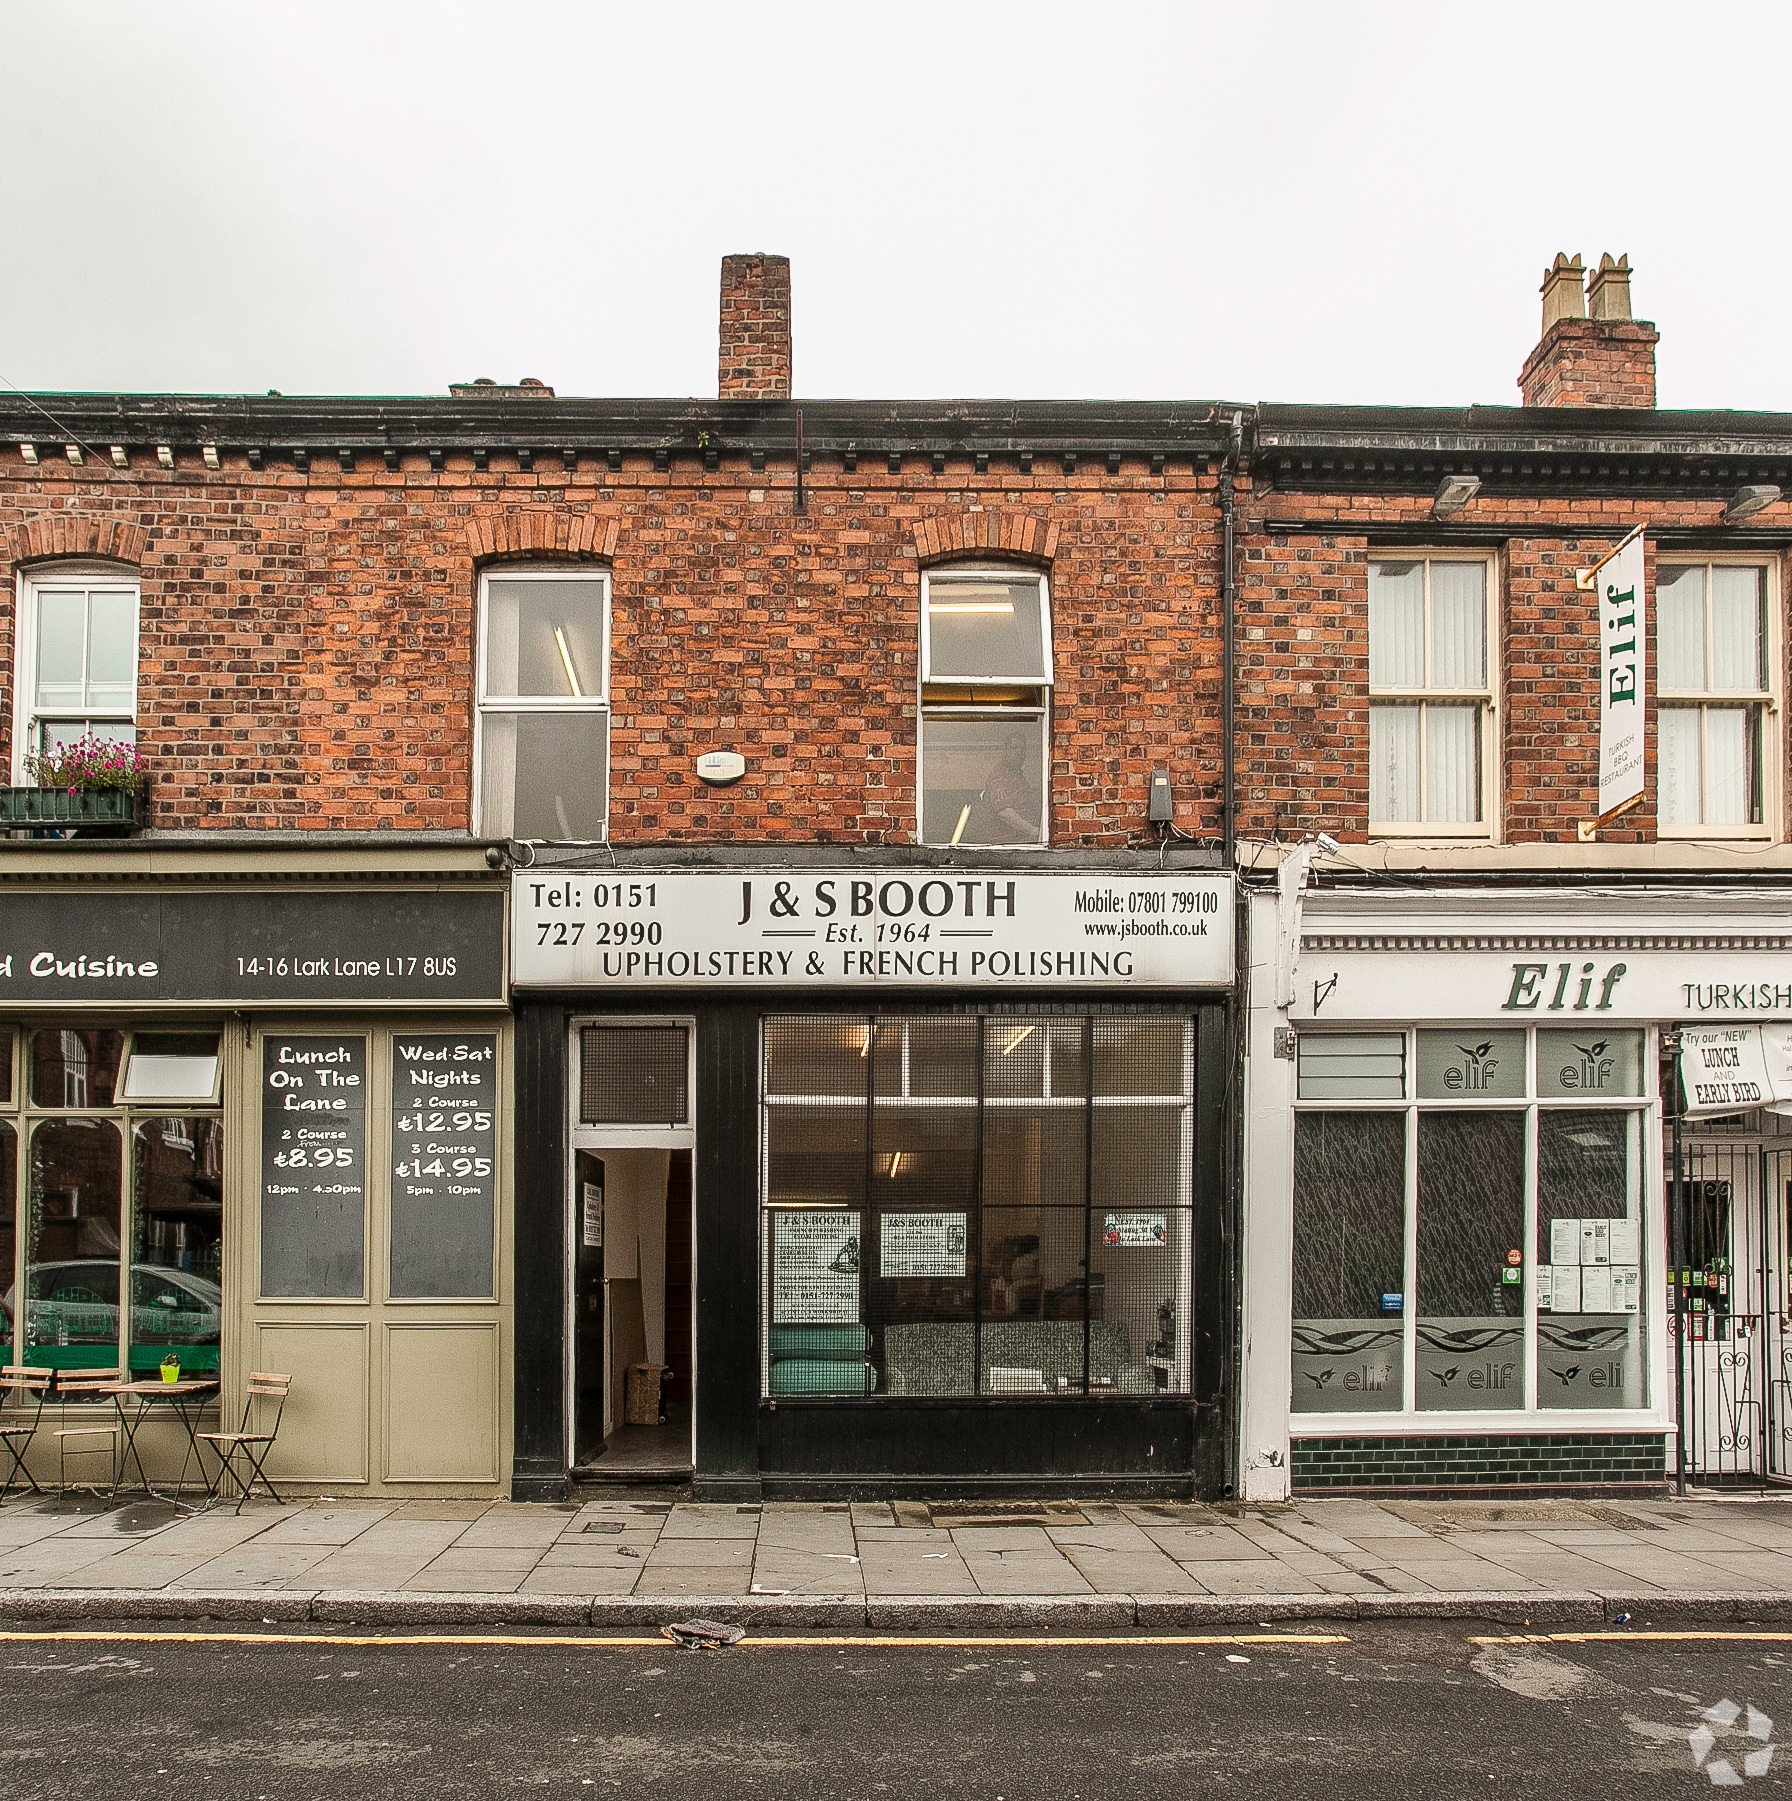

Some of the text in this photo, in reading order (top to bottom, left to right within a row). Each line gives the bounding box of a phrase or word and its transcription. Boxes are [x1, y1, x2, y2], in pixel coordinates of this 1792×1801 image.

[1607, 585, 1635, 709] Elif
[1608, 733, 1635, 757] TURKISH
[1614, 751, 1629, 767] BBQ
[1600, 754, 1643, 788] RESTAURANT
[530, 882, 656, 908] Tel: 0151
[737, 880, 1016, 925] J & S BOOTH
[1074, 889, 1218, 914] Mobile: 07801 799100
[537, 922, 662, 946] 727 2990
[825, 922, 930, 943] Est. 1964
[1084, 918, 1208, 942] www.jsbooth.co.uk
[30, 952, 159, 979] Cuisine
[237, 956, 457, 977] 14-16 Lark Lane L17 8US
[603, 950, 1133, 977] UPHOLSTERY & FRENCH POLISHING
[1501, 962, 1792, 1010] Elif TURKISH
[1686, 1033, 1700, 1046] Try
[1702, 1034, 1718, 1044] our
[279, 1046, 352, 1064] Lunch
[1701, 1047, 1740, 1068] LUNCH
[269, 1069, 361, 1088] On The
[409, 1069, 481, 1088] Nights
[1443, 1059, 1499, 1090] elif
[1559, 1058, 1615, 1088] elif
[1713, 1070, 1735, 1081] AND
[284, 1094, 347, 1111] Lane
[412, 1096, 478, 1108] 2 Course
[1695, 1081, 1761, 1105] EARLY BIRD
[281, 1128, 347, 1140] 2 Course
[411, 1142, 477, 1154] 3 Course
[266, 1184, 299, 1196] 12pm
[406, 1185, 434, 1196] 5pm
[447, 1185, 481, 1196] 10pm
[811, 1215, 851, 1226] BOOTH
[908, 1218, 943, 1227] BOOTH
[1467, 1362, 1516, 1390] elif
[1589, 1362, 1624, 1388] eli
